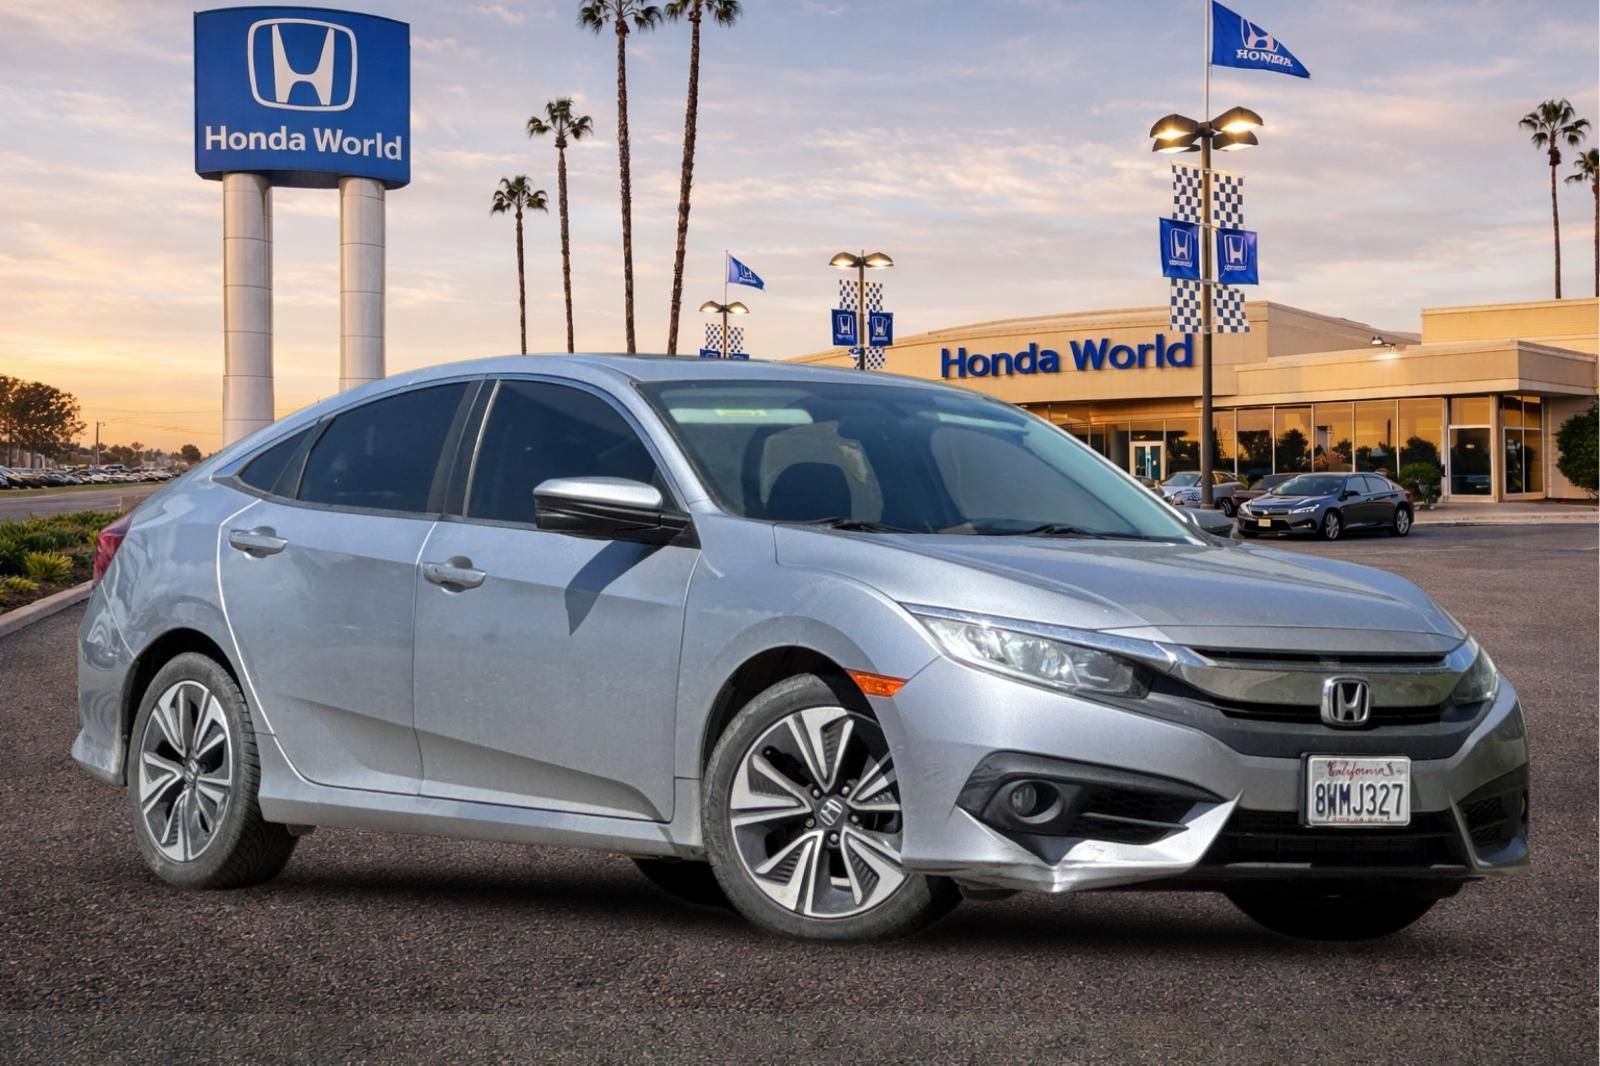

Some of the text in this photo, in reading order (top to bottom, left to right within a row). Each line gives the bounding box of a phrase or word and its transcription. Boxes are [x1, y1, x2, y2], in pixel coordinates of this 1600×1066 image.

[205, 125, 402, 161] Honda World
[941, 333, 1195, 377] Honda World
[1315, 783, 1403, 817] 8WMJ327
